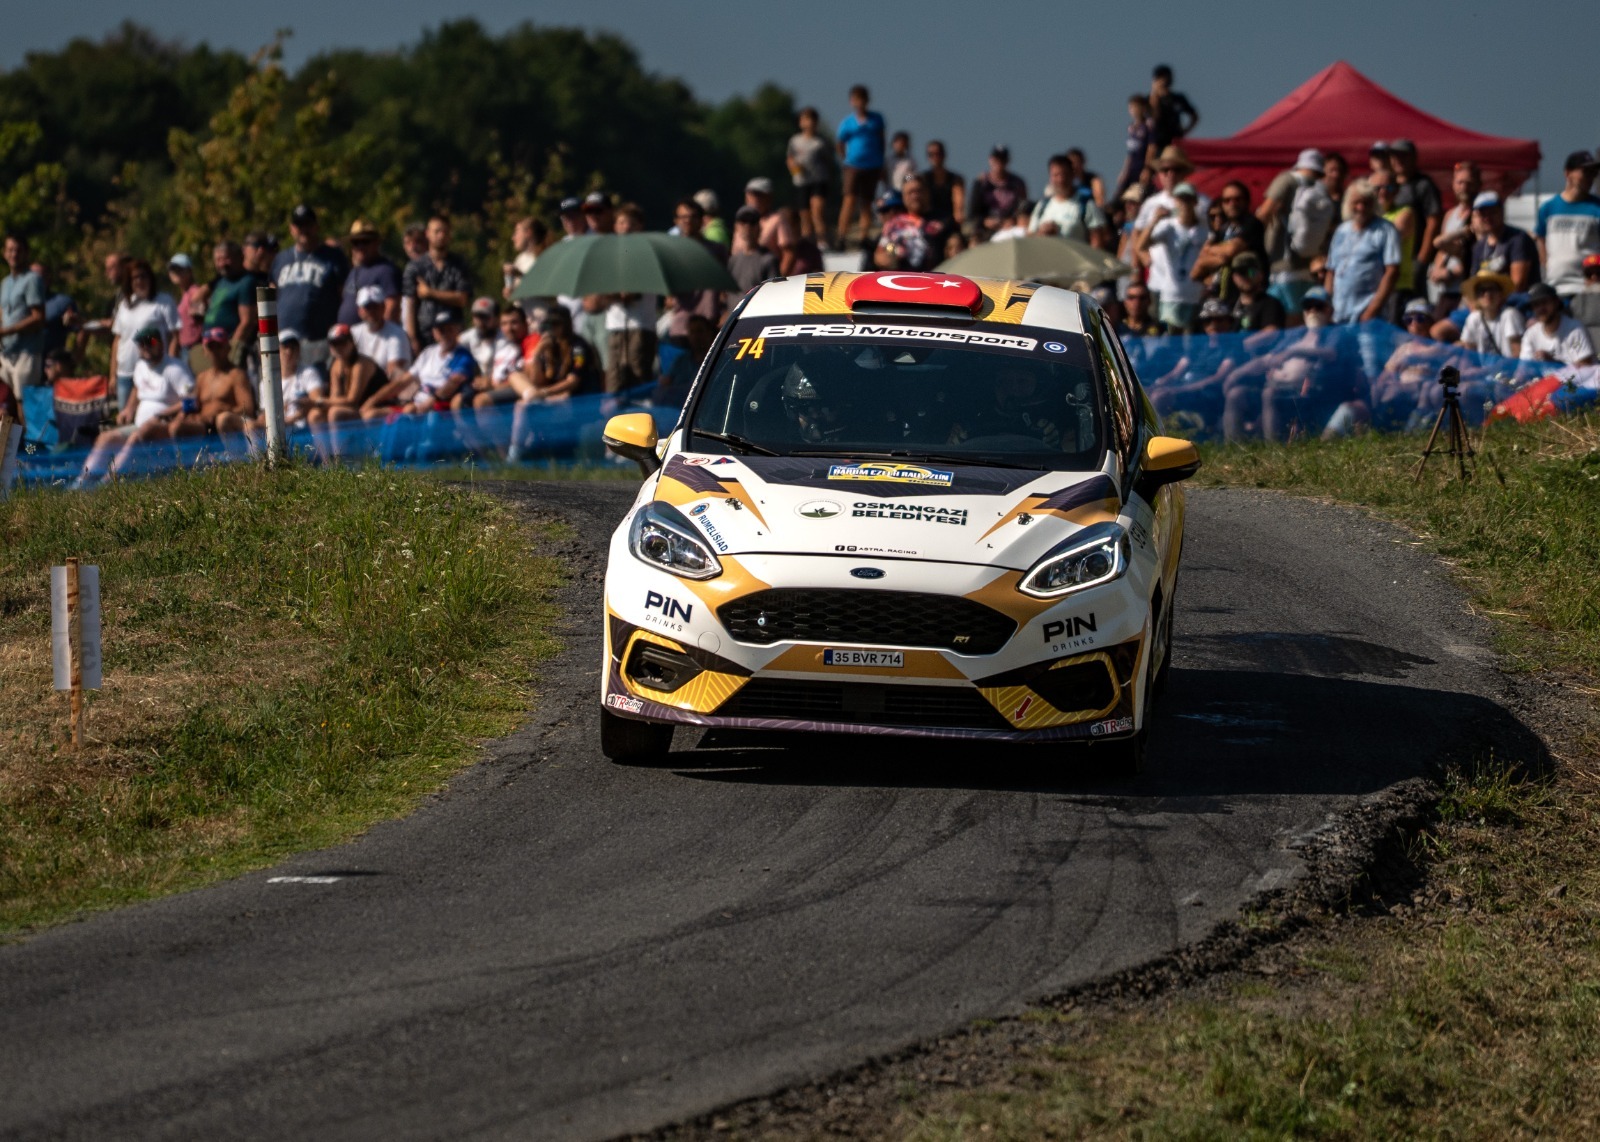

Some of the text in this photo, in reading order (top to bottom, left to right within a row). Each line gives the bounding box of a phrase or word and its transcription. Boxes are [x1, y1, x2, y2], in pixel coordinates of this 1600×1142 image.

[859, 326, 1030, 348] Motorsport
[735, 337, 765, 360] 74
[851, 510, 967, 526] BELEDİYESİ
[852, 502, 968, 517] OSMANGAZİ
[644, 590, 693, 624] PIN
[645, 614, 683, 632] DRINKS
[1043, 612, 1098, 643] PIN
[1052, 636, 1095, 652] DRINKS
[834, 652, 901, 665] 35 BVR 714
